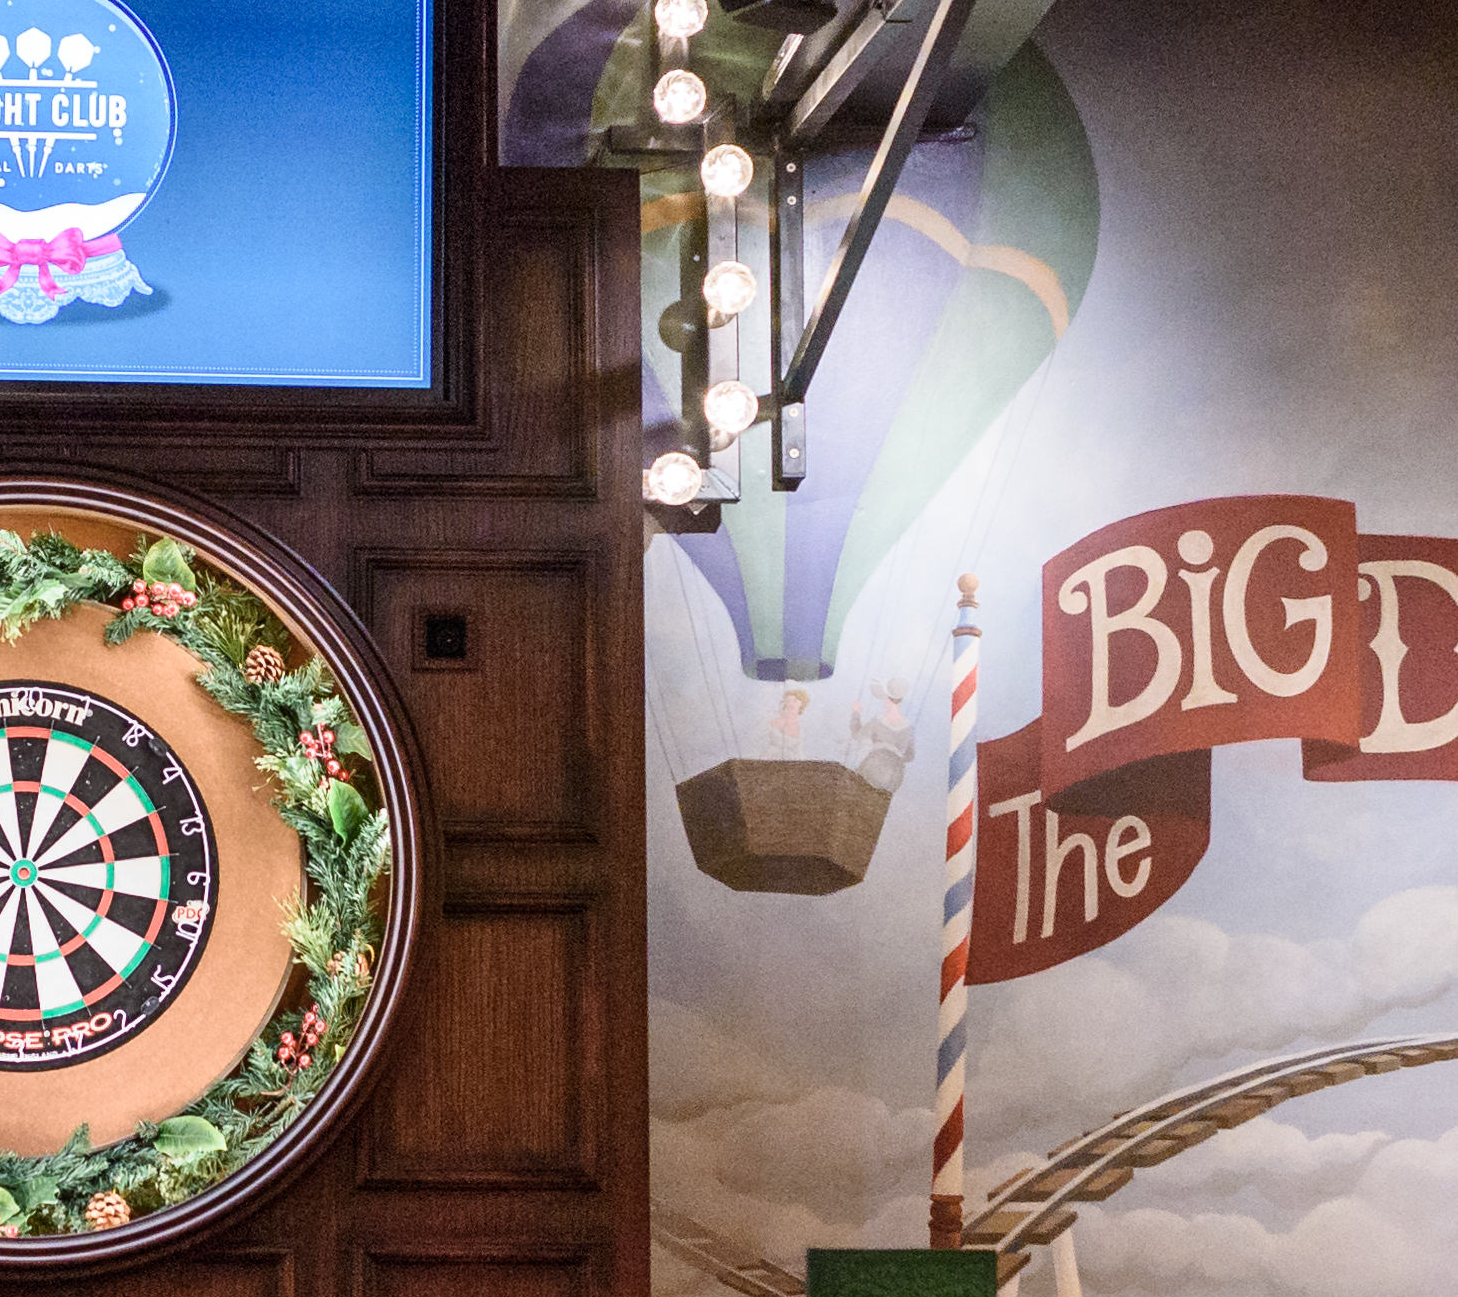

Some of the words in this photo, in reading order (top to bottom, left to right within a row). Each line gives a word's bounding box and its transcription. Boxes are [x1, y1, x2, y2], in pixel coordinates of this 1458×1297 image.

[51, 93, 128, 129] CLUB
[54, 161, 104, 175] DARTS
[121, 720, 146, 747] 18
[162, 766, 183, 785] 4
[179, 812, 205, 836] 13
[187, 871, 210, 886] 6
[988, 789, 1154, 945] The
[50, 1012, 114, 1047] PRO
